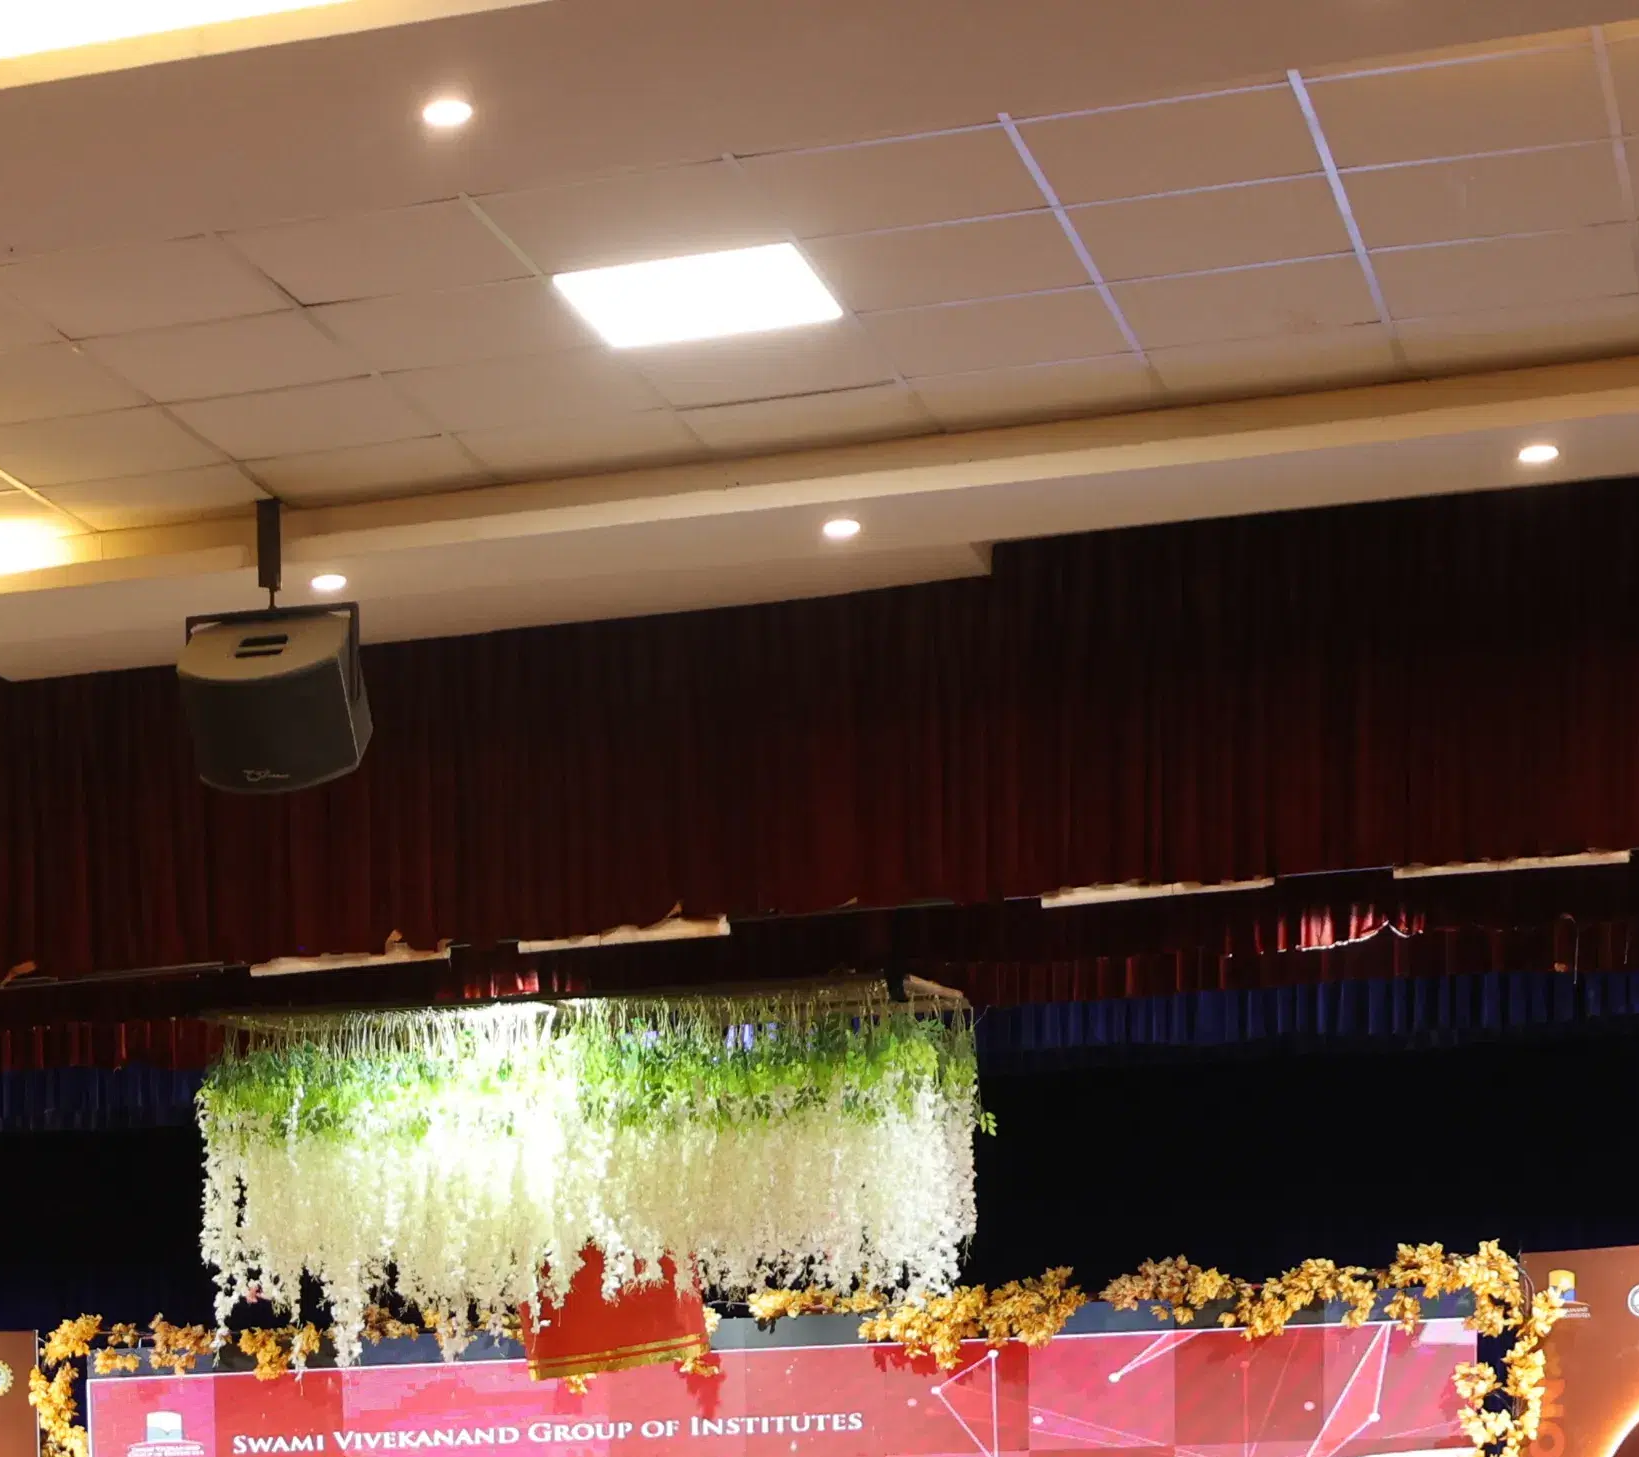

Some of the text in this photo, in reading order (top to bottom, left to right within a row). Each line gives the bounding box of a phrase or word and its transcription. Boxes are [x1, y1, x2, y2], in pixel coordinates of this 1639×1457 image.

[232, 1411, 863, 1455] SWAMI VIVEKANAND GROUP OF INSTITUTES
